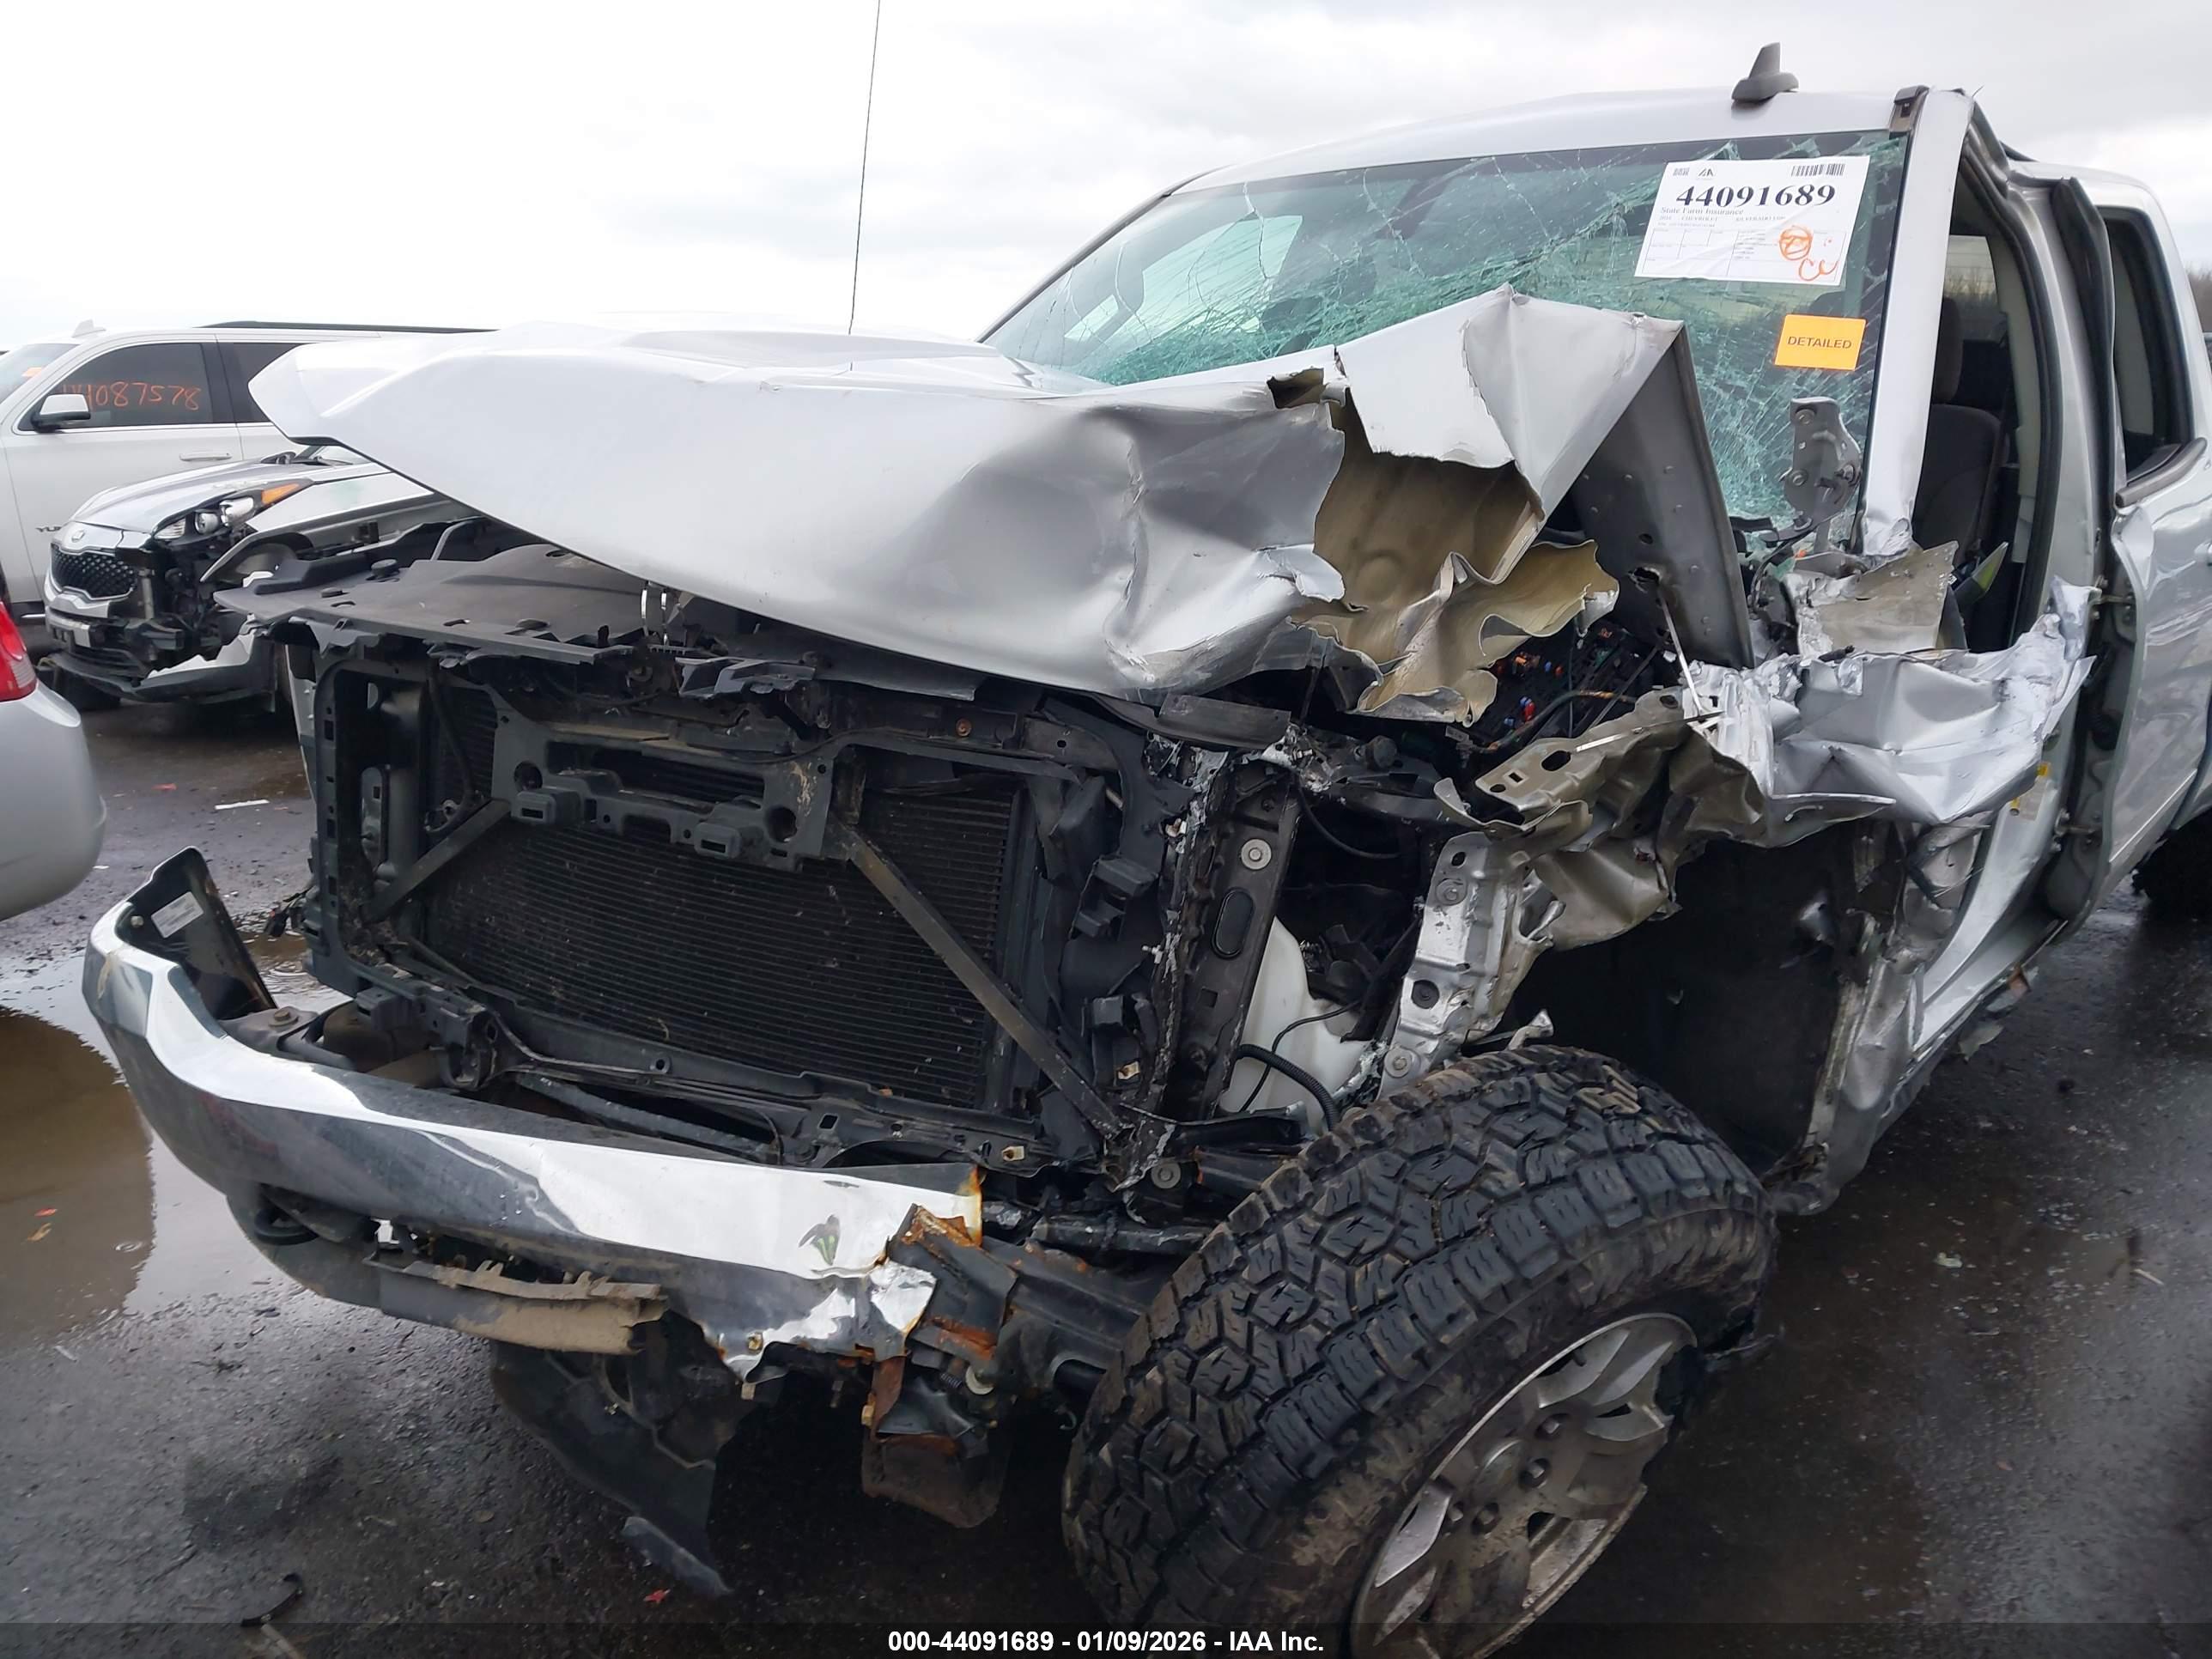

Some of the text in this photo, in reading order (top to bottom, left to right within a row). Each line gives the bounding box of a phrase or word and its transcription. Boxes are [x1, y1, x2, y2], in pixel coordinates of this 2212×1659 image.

[1676, 184, 1836, 208] 44091689
[1662, 206, 1680, 215] State
[1787, 336, 1852, 349] DETAILED
